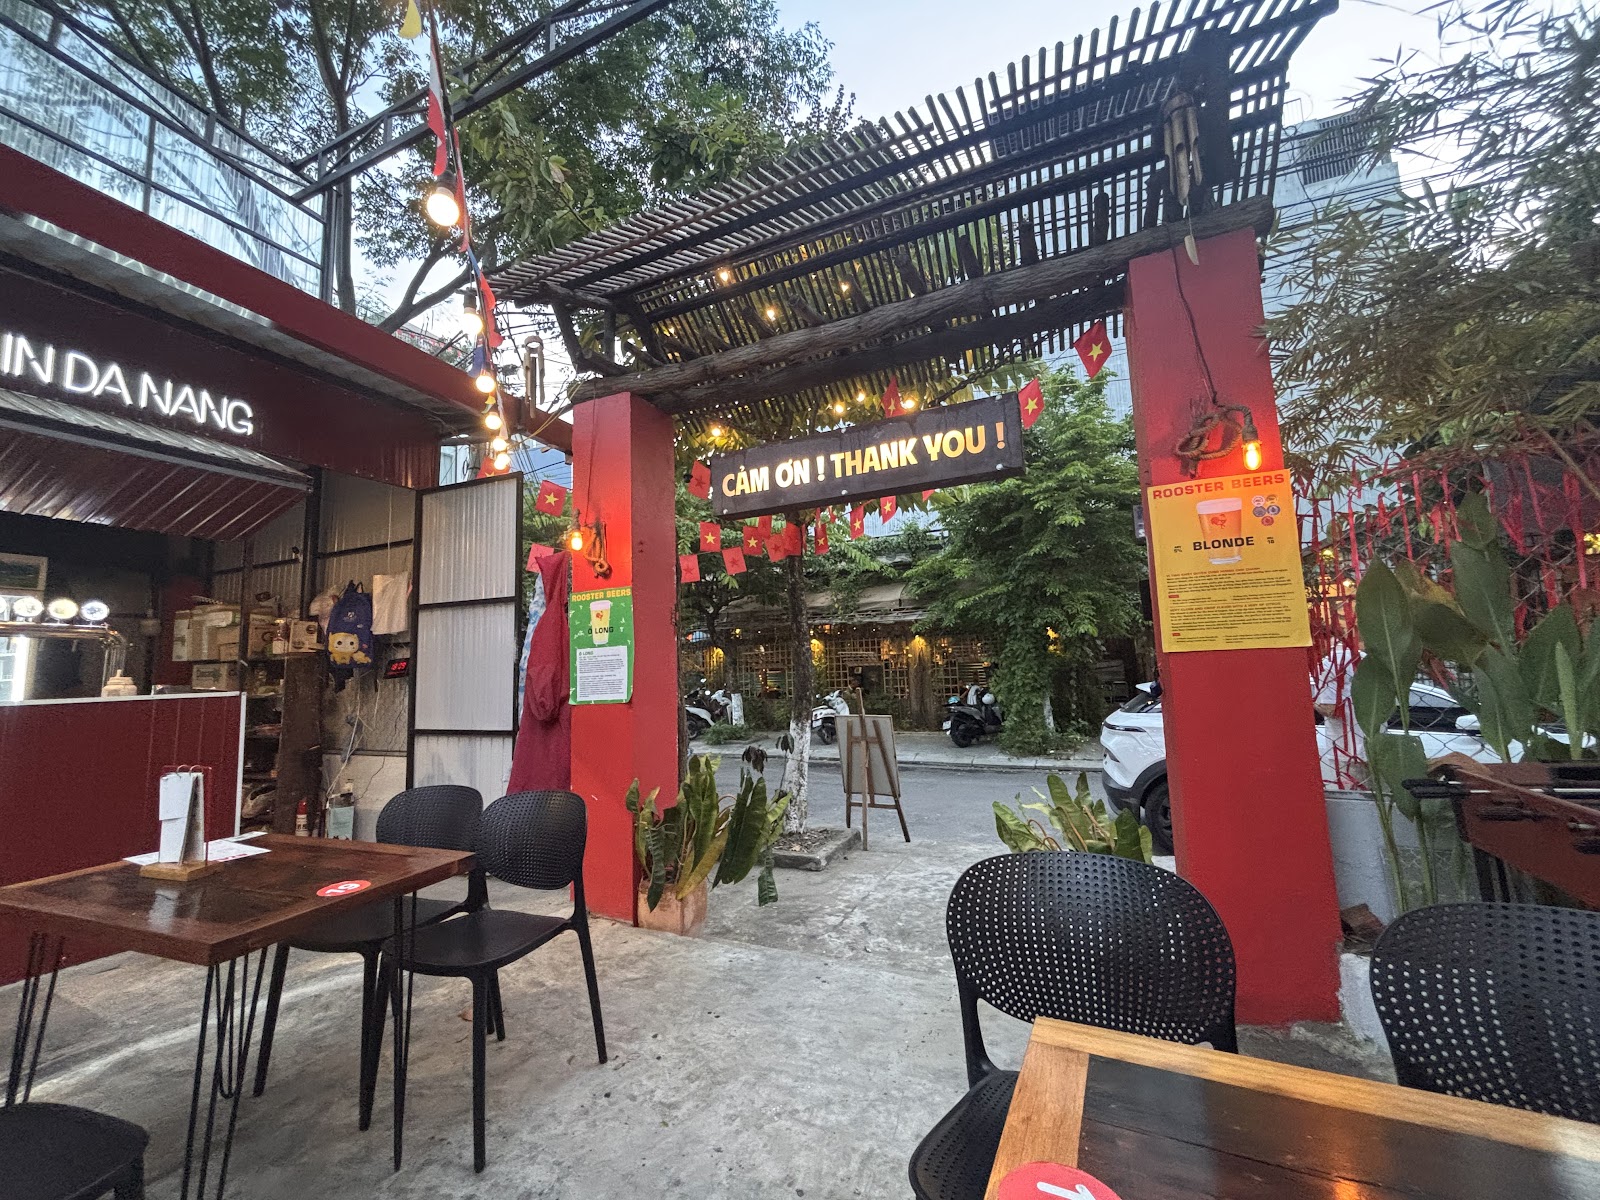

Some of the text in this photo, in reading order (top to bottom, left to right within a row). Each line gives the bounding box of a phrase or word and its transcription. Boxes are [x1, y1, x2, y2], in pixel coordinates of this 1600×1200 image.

[1, 332, 254, 436] IN DA NANG
[830, 437, 918, 479] THANK
[922, 425, 986, 462] YOU
[995, 421, 1006, 450] !
[1152, 473, 1285, 500] ROOSTER BEERS
[1192, 536, 1255, 552] BLONDE
[571, 588, 631, 603] ROOSTER BEERS
[594, 626, 614, 635] LONG
